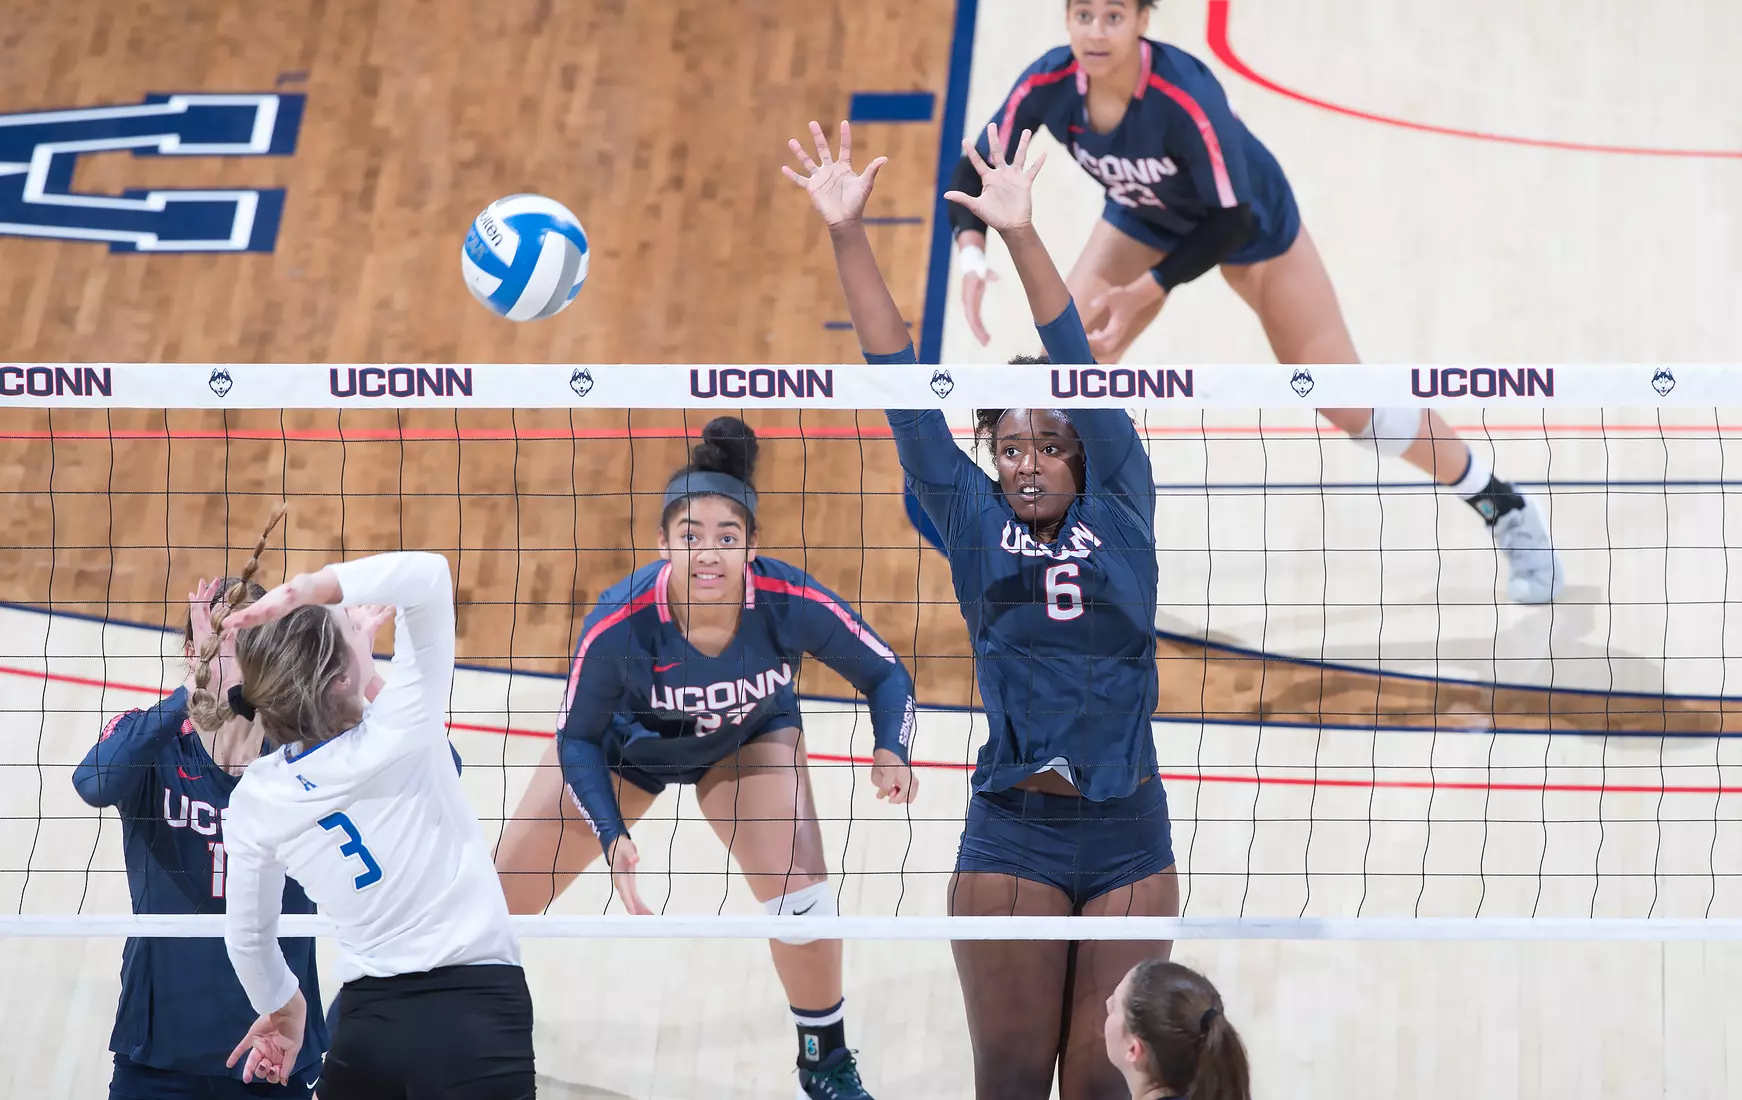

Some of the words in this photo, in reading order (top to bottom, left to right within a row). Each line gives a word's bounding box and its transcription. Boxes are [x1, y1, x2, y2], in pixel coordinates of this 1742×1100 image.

[330, 367, 472, 397] UCONN
[690, 367, 833, 398] UCONN
[1051, 368, 1193, 398] UCONN
[1411, 368, 1554, 398] UCONN
[1045, 562, 1084, 621] 6
[650, 663, 792, 712] UCONN
[316, 810, 384, 892] 3
